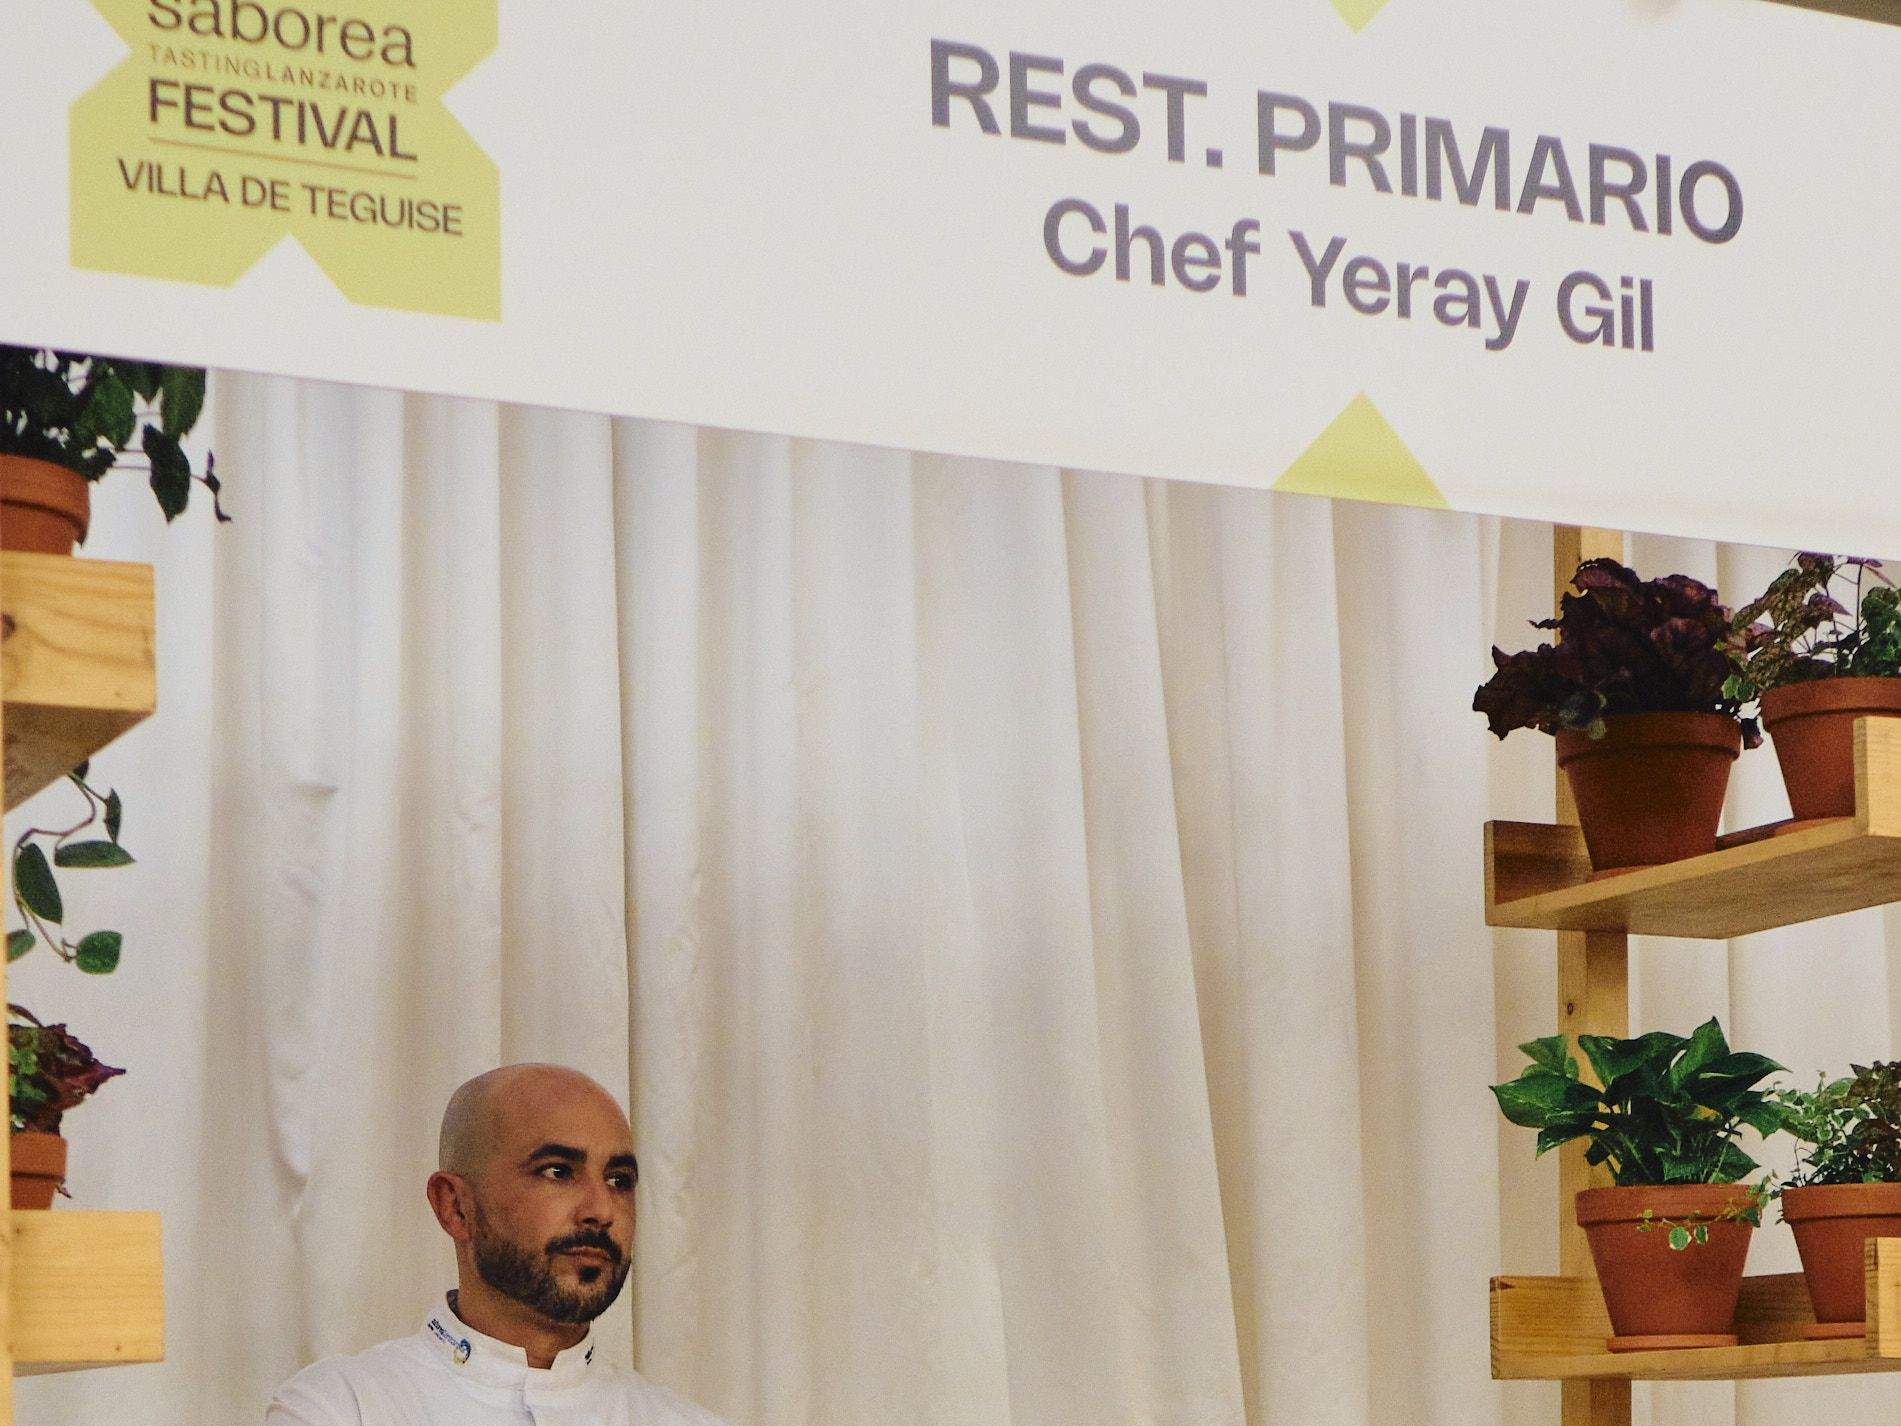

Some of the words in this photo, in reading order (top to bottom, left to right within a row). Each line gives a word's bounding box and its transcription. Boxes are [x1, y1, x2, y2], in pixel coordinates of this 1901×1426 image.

[148, 0, 416, 68] saborea
[148, 77, 419, 162] FESTIVAL
[929, 37, 1224, 169] REST.
[1256, 89, 1745, 246] PRIMARIO
[116, 156, 231, 204] VILLA
[240, 175, 291, 213] DE
[302, 183, 464, 237] TEGUISE
[1042, 197, 1261, 297] Chef
[1288, 229, 1530, 352] Yeray
[1555, 270, 1656, 353] Gil
